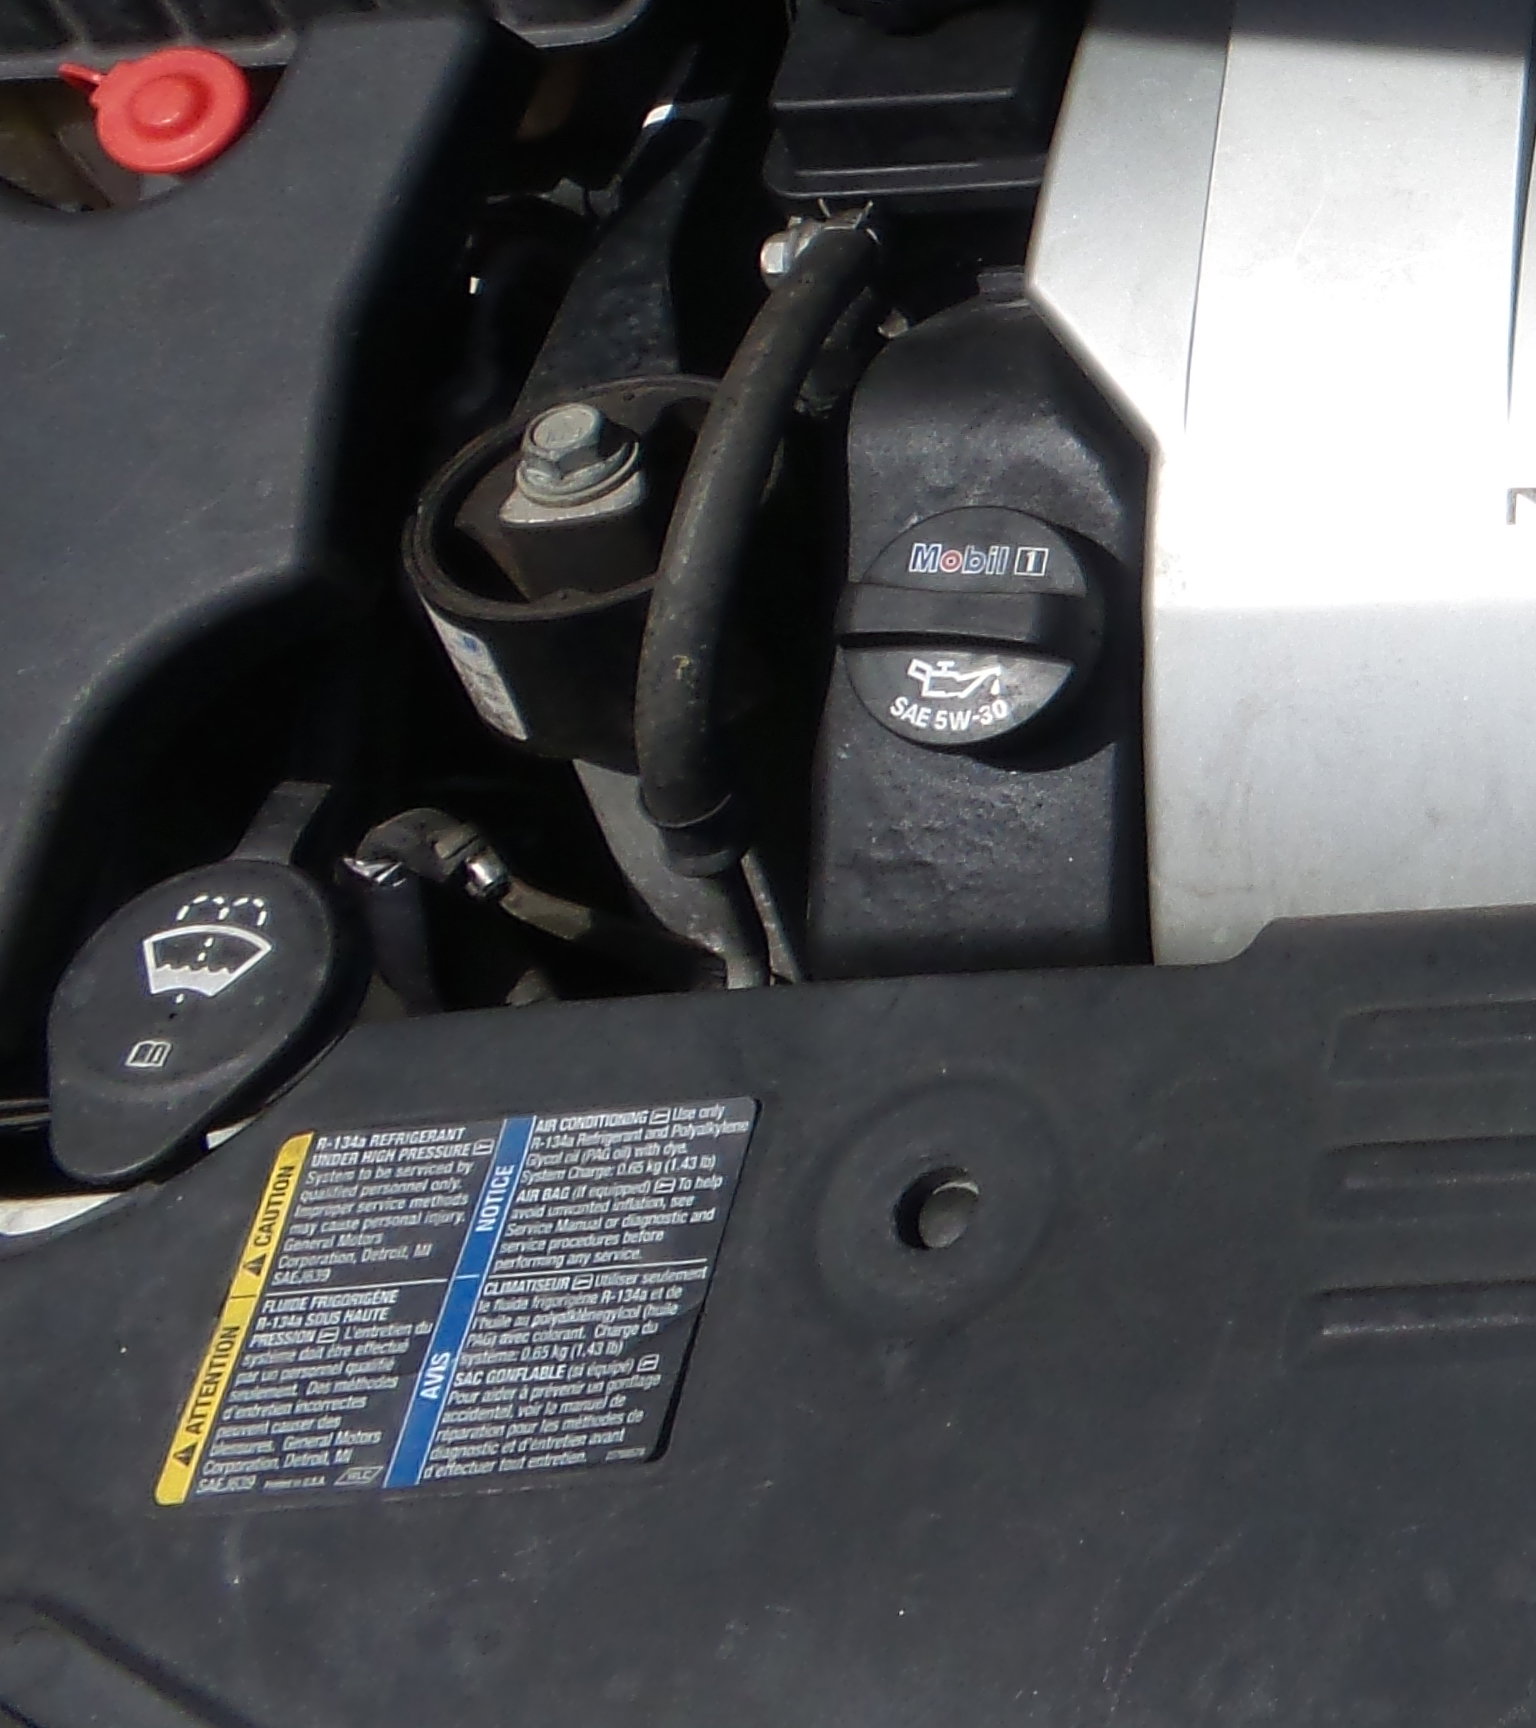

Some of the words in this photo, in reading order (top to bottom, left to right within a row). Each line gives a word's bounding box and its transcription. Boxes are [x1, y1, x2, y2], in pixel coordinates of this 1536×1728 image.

[909, 543, 1010, 575] Mobil
[889, 696, 932, 729] SAE
[933, 699, 1009, 731] 5W-30
[536, 1120, 556, 1131] AIR
[560, 1111, 648, 1129] CONDITIONING
[672, 1108, 695, 1120] Use
[698, 1104, 724, 1120] only
[316, 1134, 367, 1150] R-134a
[369, 1127, 465, 1146] REFRIGERANT
[530, 1134, 575, 1148] R-134a
[645, 1127, 668, 1138] and
[310, 1151, 358, 1167] UNDER
[361, 1148, 395, 1163] HIGH
[399, 1143, 471, 1160] PRESSURE
[634, 1143, 660, 1156] with
[304, 1168, 355, 1185] System
[358, 1168, 371, 1179] to
[374, 1166, 392, 1178] be
[395, 1161, 453, 1176] serviced
[455, 1160, 474, 1174] by
[519, 1168, 565, 1185] System
[645, 1160, 662, 1175] kg
[298, 1185, 357, 1202] qualified
[360, 1180, 427, 1196] personnel
[474, 1165, 513, 1232] NOTICE
[516, 1189, 539, 1202] AIR
[542, 1187, 569, 1200] BAG
[678, 1178, 691, 1189] To
[693, 1174, 722, 1190] help
[253, 1164, 295, 1246] CAUTION
[293, 1202, 352, 1219] Improper
[356, 1198, 405, 1212] service
[409, 1193, 469, 1208] methods
[510, 1205, 545, 1219] avoid
[547, 1200, 609, 1216] unwanted
[670, 1196, 694, 1206] see
[287, 1222, 317, 1236] may
[320, 1219, 359, 1231] cause
[362, 1212, 421, 1230] personal
[505, 1220, 552, 1236] Service
[555, 1216, 603, 1232] Manual
[604, 1218, 619, 1228] or
[620, 1210, 688, 1229] diagnostic
[690, 1207, 715, 1221] and
[282, 1235, 335, 1251] General
[337, 1231, 383, 1246] Motors
[414, 1243, 431, 1256] MI
[500, 1238, 546, 1252] service
[546, 1234, 620, 1254] procedures
[623, 1230, 664, 1243] before
[493, 1252, 564, 1272] performing
[566, 1254, 590, 1266] any
[484, 1277, 570, 1295] CLIMATISEUR
[601, 1288, 648, 1303] R-134a
[650, 1287, 663, 1299] et
[665, 1285, 683, 1299] de
[262, 1297, 309, 1312] FLUIDE
[304, 1311, 341, 1326] SOUS
[343, 1307, 390, 1323] HAUTE
[249, 1329, 315, 1347] PRESSION
[414, 1321, 433, 1334] du
[499, 1332, 529, 1344] avec
[593, 1322, 640, 1339] Charge
[641, 1320, 659, 1334] du
[521, 1346, 549, 1359] 0.65
[550, 1345, 568, 1360] kg
[570, 1342, 603, 1358] (1.43
[186, 1325, 241, 1436] ATTENTION
[418, 1351, 451, 1400] AVIS
[453, 1371, 483, 1386] SAC
[485, 1364, 566, 1383] GONFLABLE
[448, 1390, 479, 1404] Pour
[586, 1381, 603, 1392] un
[609, 1394, 626, 1407] de
[506, 1422, 536, 1437] pour
[539, 1418, 559, 1432] les
[626, 1408, 644, 1422] de
[282, 1432, 332, 1450] General
[335, 1428, 382, 1446] Motors
[501, 1439, 515, 1452] et
[334, 1448, 352, 1463] MI
